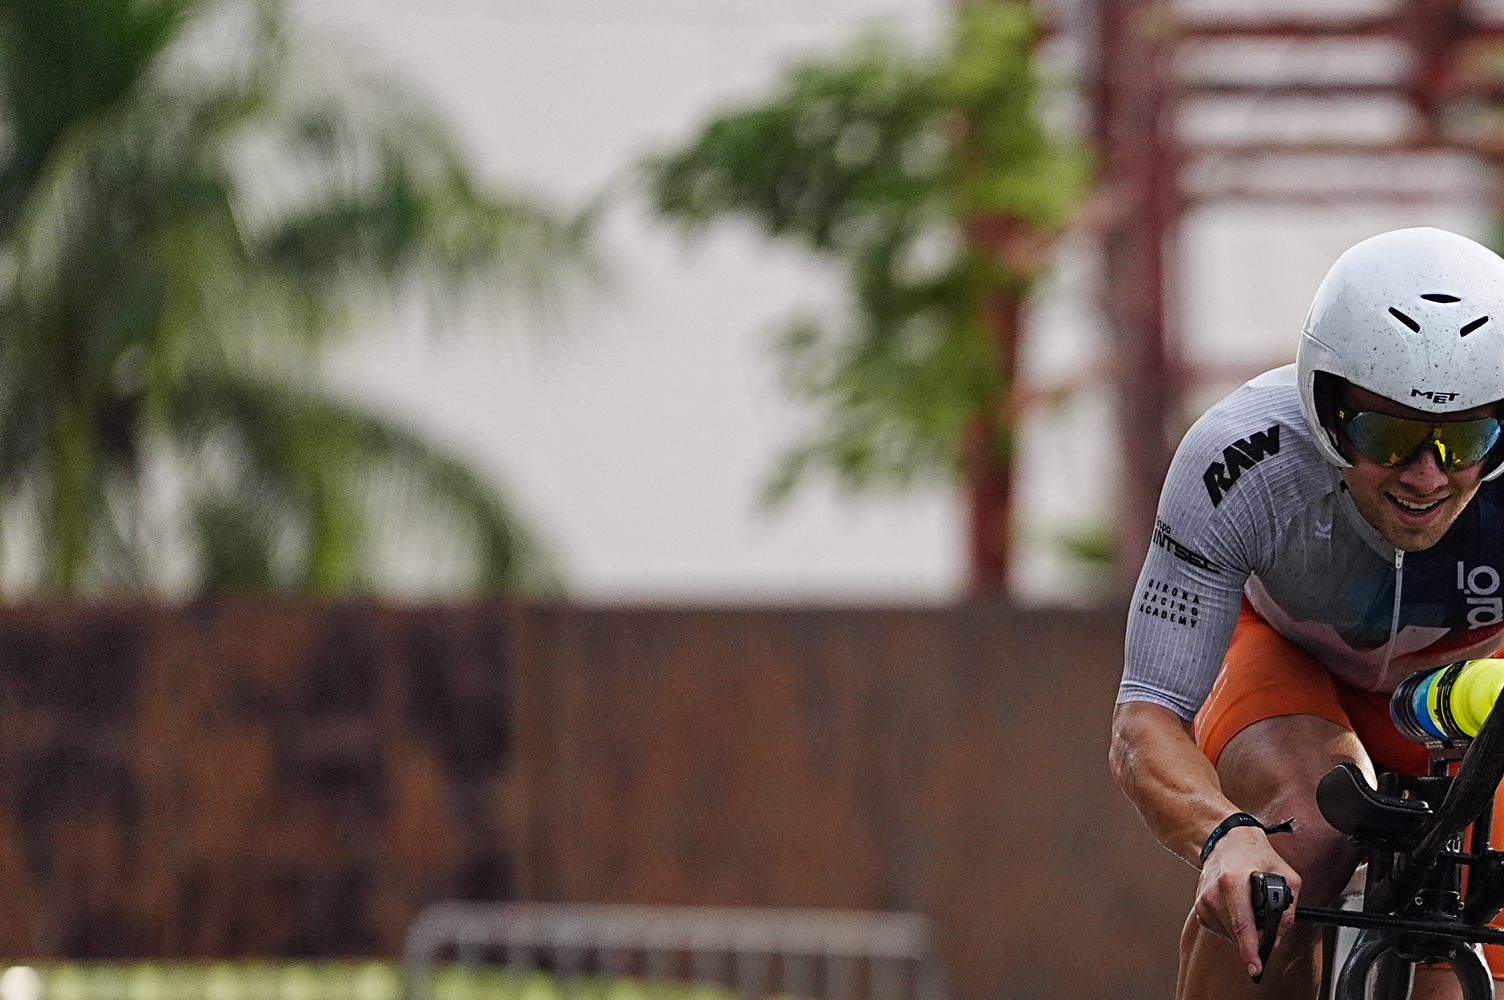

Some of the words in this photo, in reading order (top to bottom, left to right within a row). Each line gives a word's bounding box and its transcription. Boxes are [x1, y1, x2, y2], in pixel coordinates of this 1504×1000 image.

[1410, 388, 1460, 404] MET
[1203, 424, 1280, 509] RAW
[1143, 591, 1198, 617] RACING
[1148, 578, 1200, 605] GIRONA
[1139, 603, 1197, 628] ACADEMY
